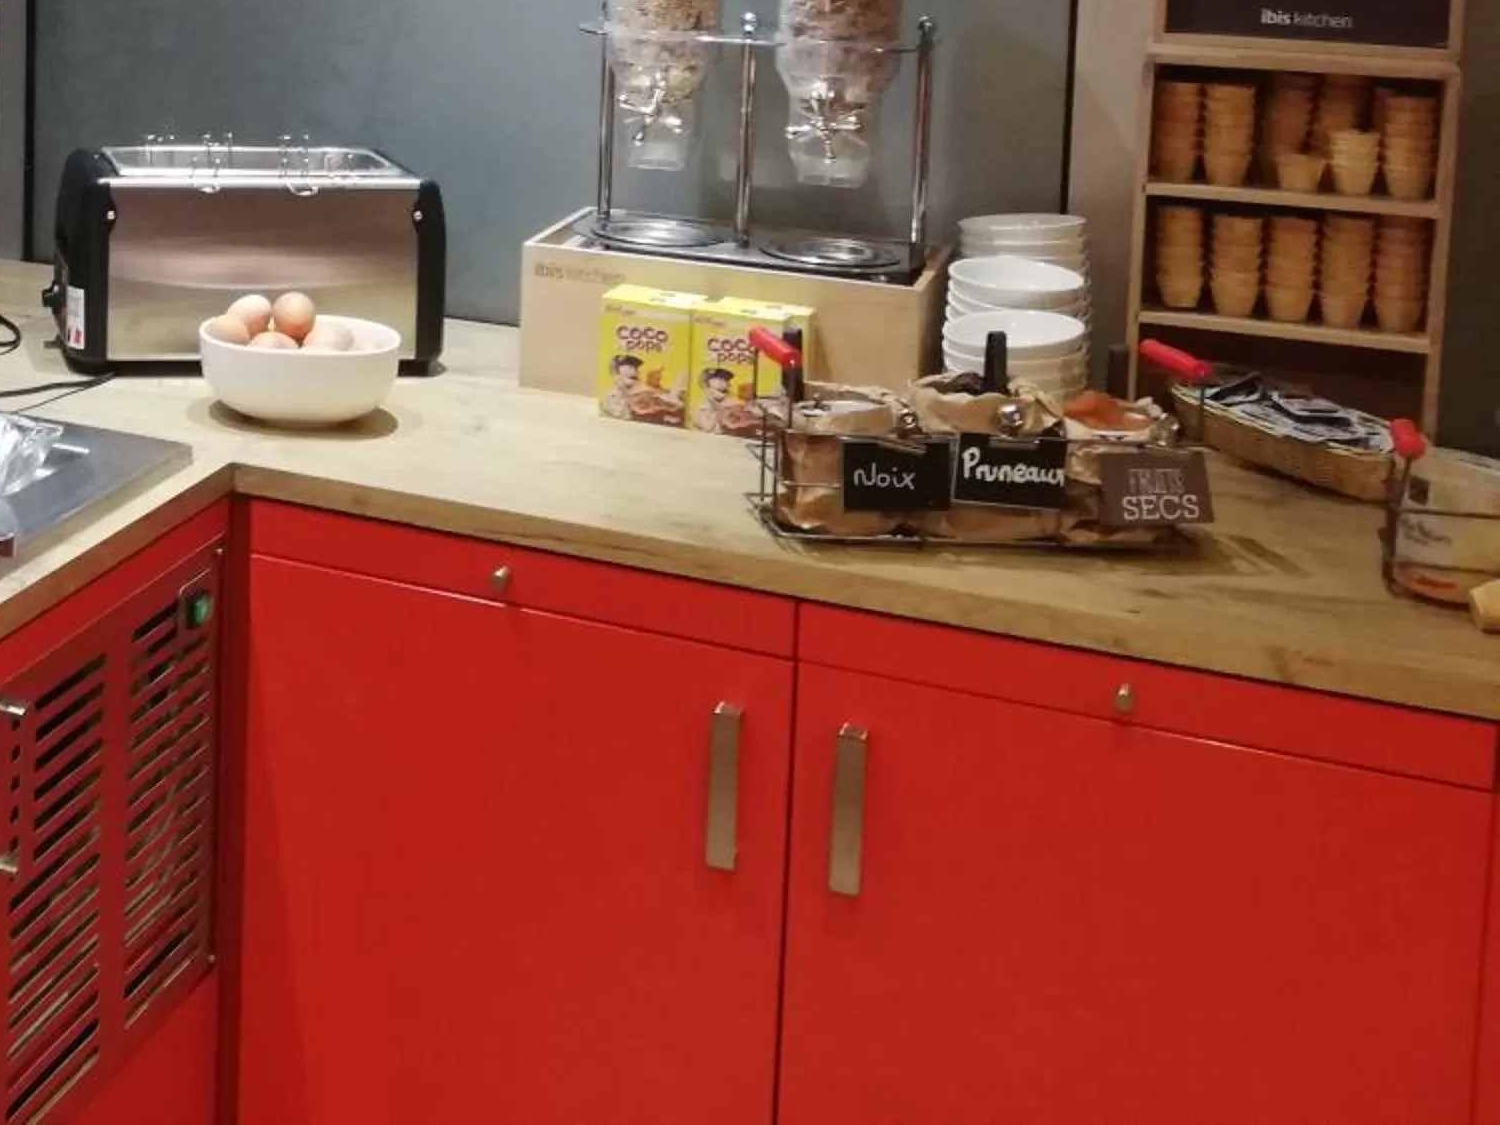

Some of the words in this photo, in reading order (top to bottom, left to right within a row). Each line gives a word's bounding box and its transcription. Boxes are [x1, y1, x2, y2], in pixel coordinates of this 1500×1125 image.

[1260, 7, 1291, 25] ibis
[1293, 10, 1353, 28] kitchen
[853, 462, 916, 490] Noix
[1122, 494, 1200, 521] SECS
